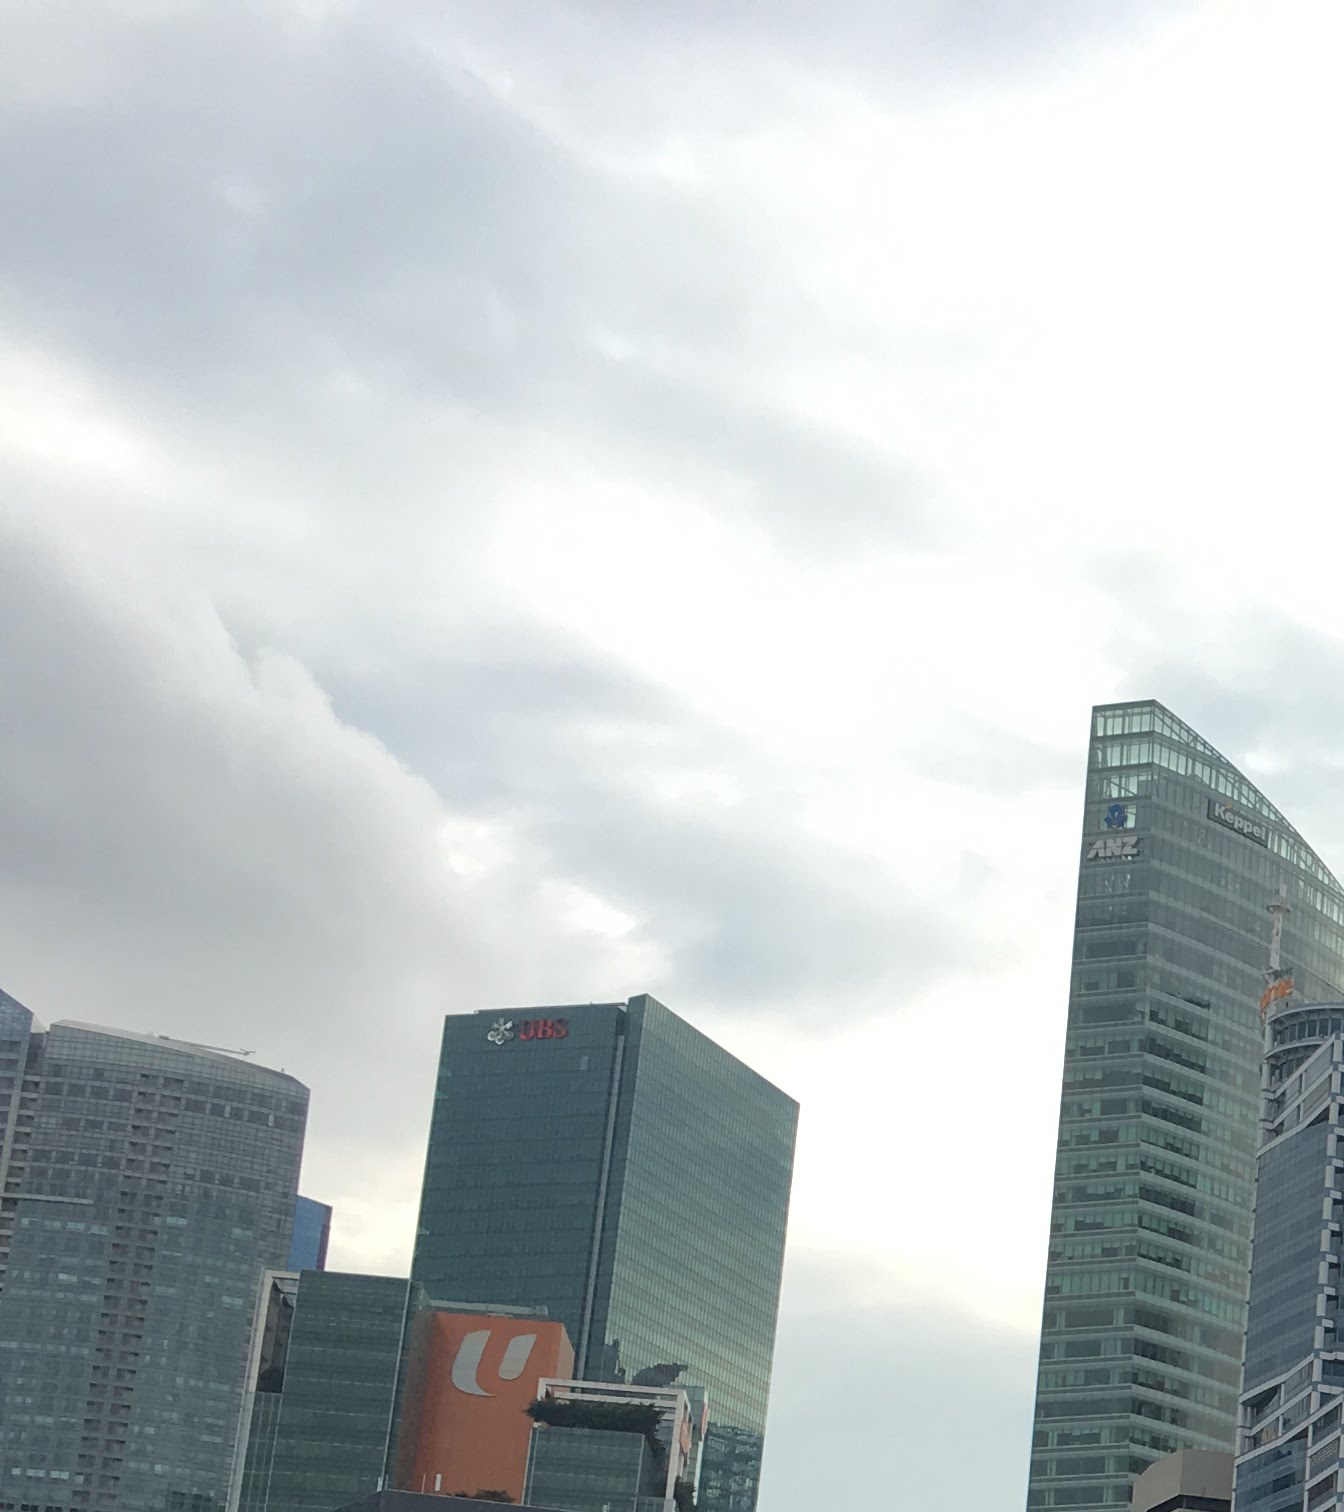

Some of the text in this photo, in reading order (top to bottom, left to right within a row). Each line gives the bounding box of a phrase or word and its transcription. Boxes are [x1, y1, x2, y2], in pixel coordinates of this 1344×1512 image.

[1214, 802, 1266, 841] Keppel
[1086, 836, 1139, 860] ANZ
[518, 1018, 568, 1040] UBS
